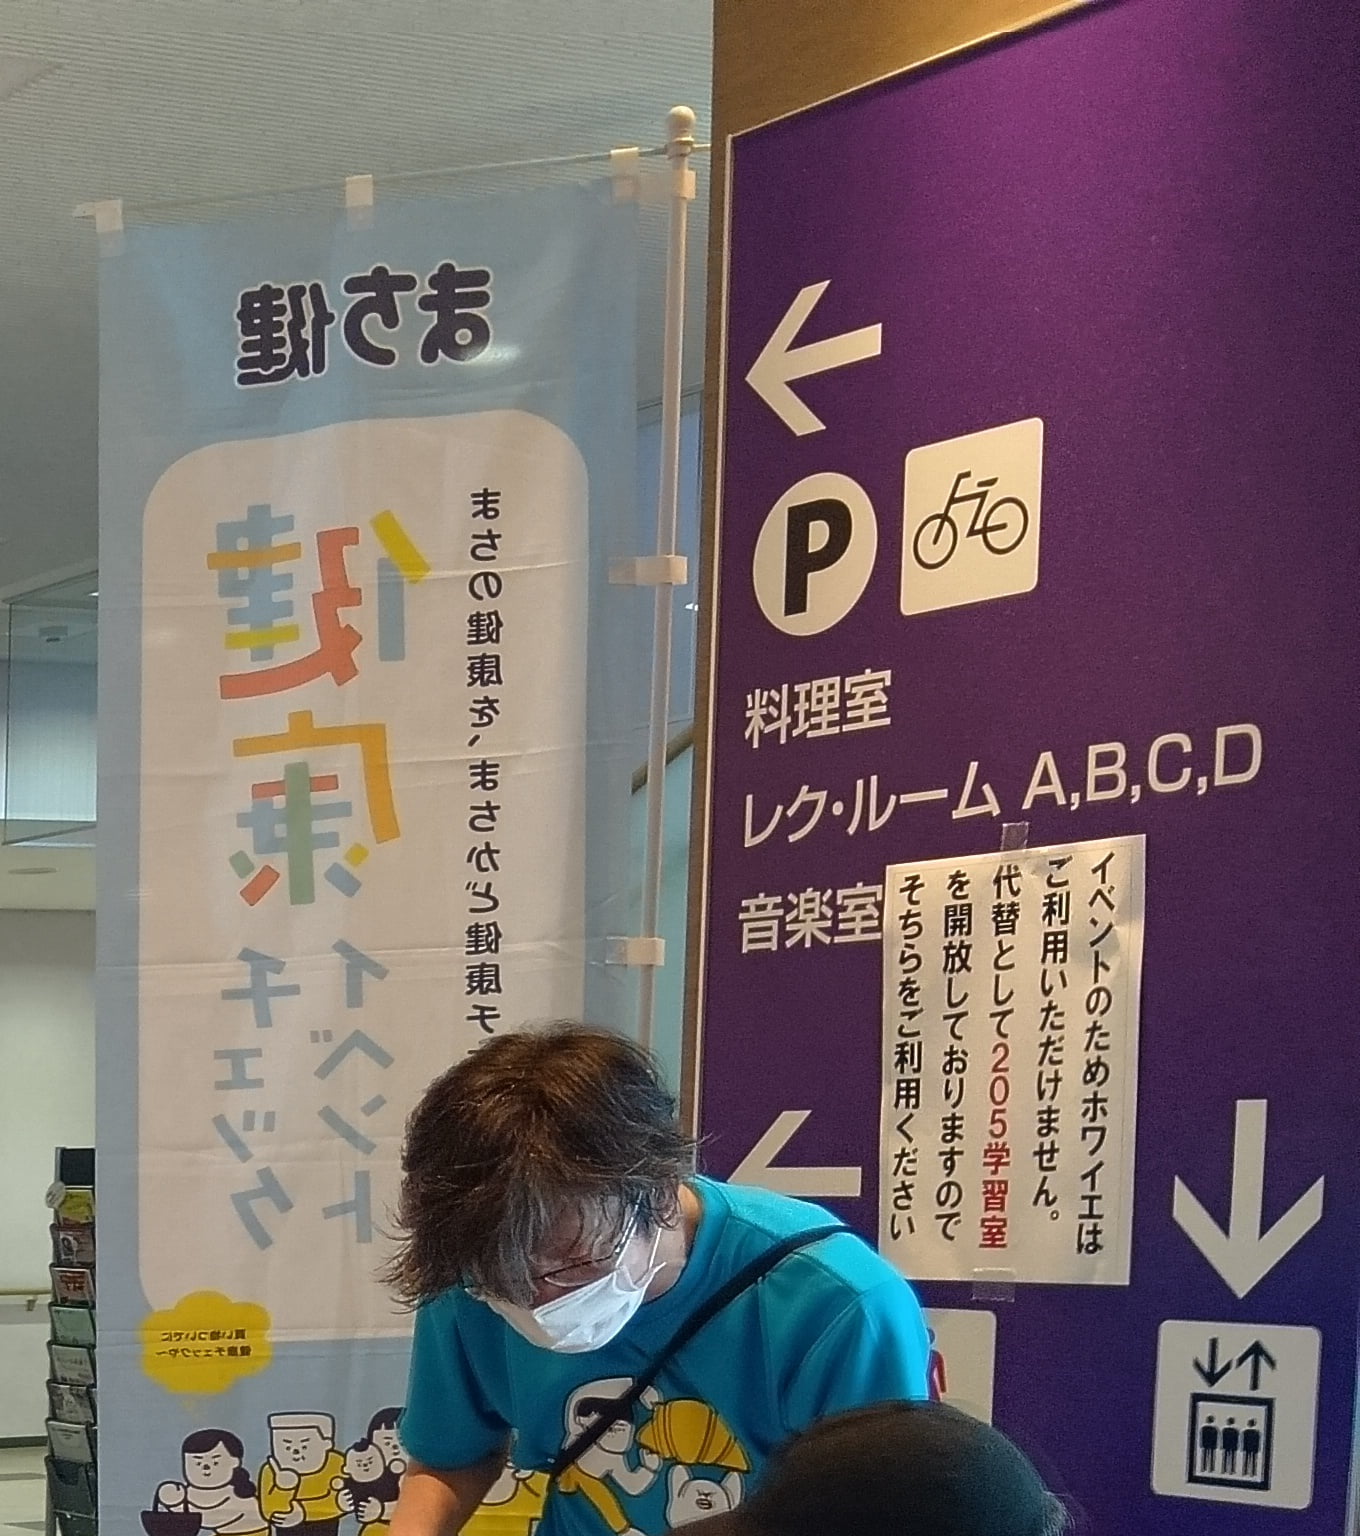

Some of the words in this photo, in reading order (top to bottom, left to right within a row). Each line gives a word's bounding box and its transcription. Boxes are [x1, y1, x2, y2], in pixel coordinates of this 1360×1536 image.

[784, 498, 853, 616] P
[743, 761, 1001, 847] レク・ルーム
[1022, 724, 1263, 811] A,B,C,D
[744, 669, 893, 749] 料理室
[738, 883, 882, 955] 音楽室
[1032, 855, 1075, 1223] ご利用いただけません。
[890, 873, 926, 1241] そちらをご利用ください
[935, 870, 973, 1241] を開放しておりますので
[1076, 851, 1116, 1254] イベントのためホワイエは
